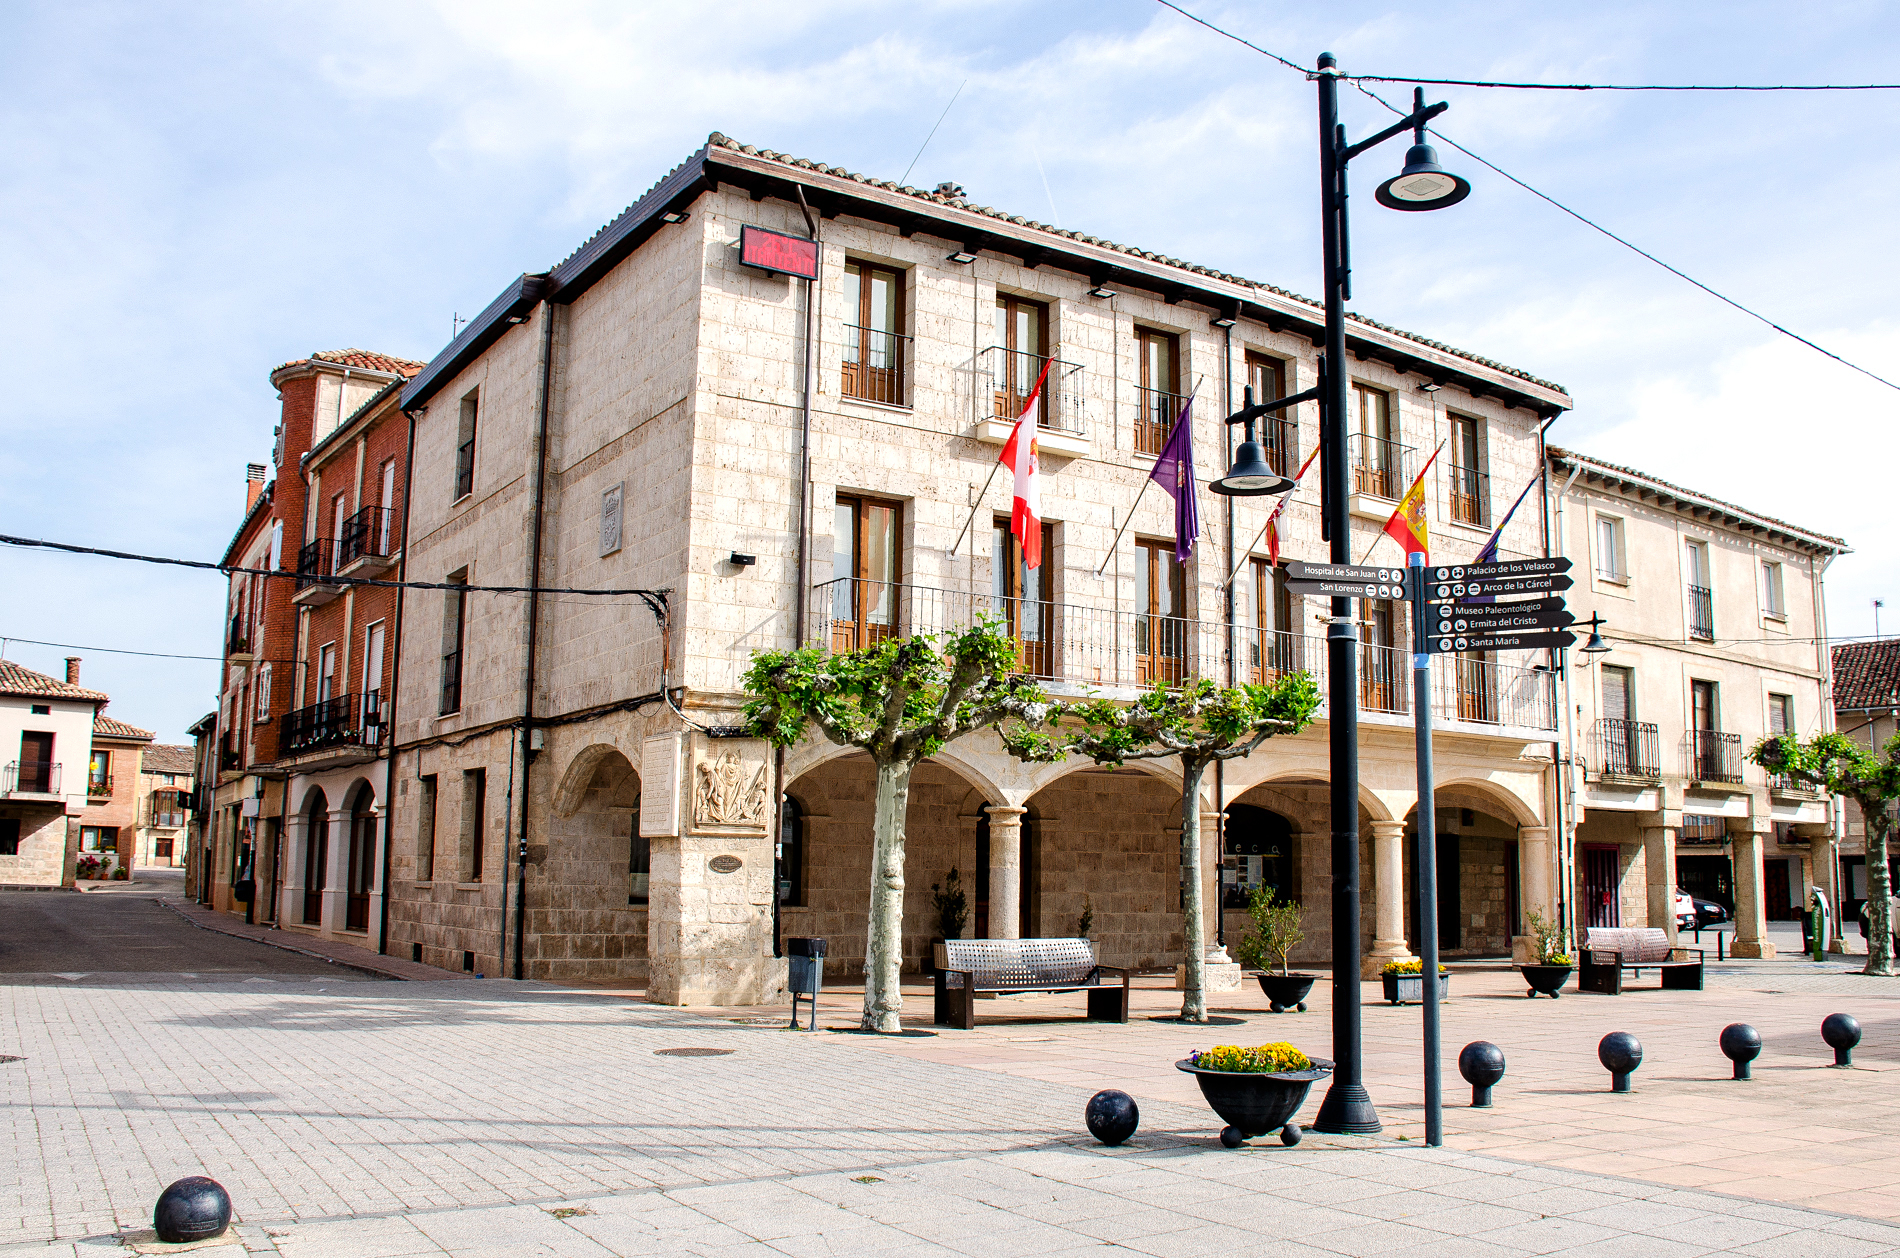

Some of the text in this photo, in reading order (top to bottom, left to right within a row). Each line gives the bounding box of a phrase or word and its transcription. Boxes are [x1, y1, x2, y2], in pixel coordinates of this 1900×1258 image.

[1304, 566, 1334, 577] Hospital
[1335, 568, 1344, 576] de
[1345, 569, 1359, 577] San
[1359, 570, 1376, 579] Juan
[1467, 566, 1496, 576] Palacio
[1497, 565, 1509, 573] de
[1510, 563, 1522, 572] los
[1523, 561, 1556, 571] Velasco
[1320, 583, 1334, 591] San
[1335, 583, 1363, 593] Lorenzo
[1483, 584, 1503, 592] Arco
[1504, 581, 1515, 590] de
[1516, 581, 1524, 589] la
[1525, 579, 1552, 589] Cárcel
[1455, 602, 1542, 615] Museo Paleontológico
[1470, 619, 1497, 628] Ermita
[1498, 617, 1512, 626] del
[1513, 616, 1538, 626] Cristo
[1470, 637, 1494, 647] Santa
